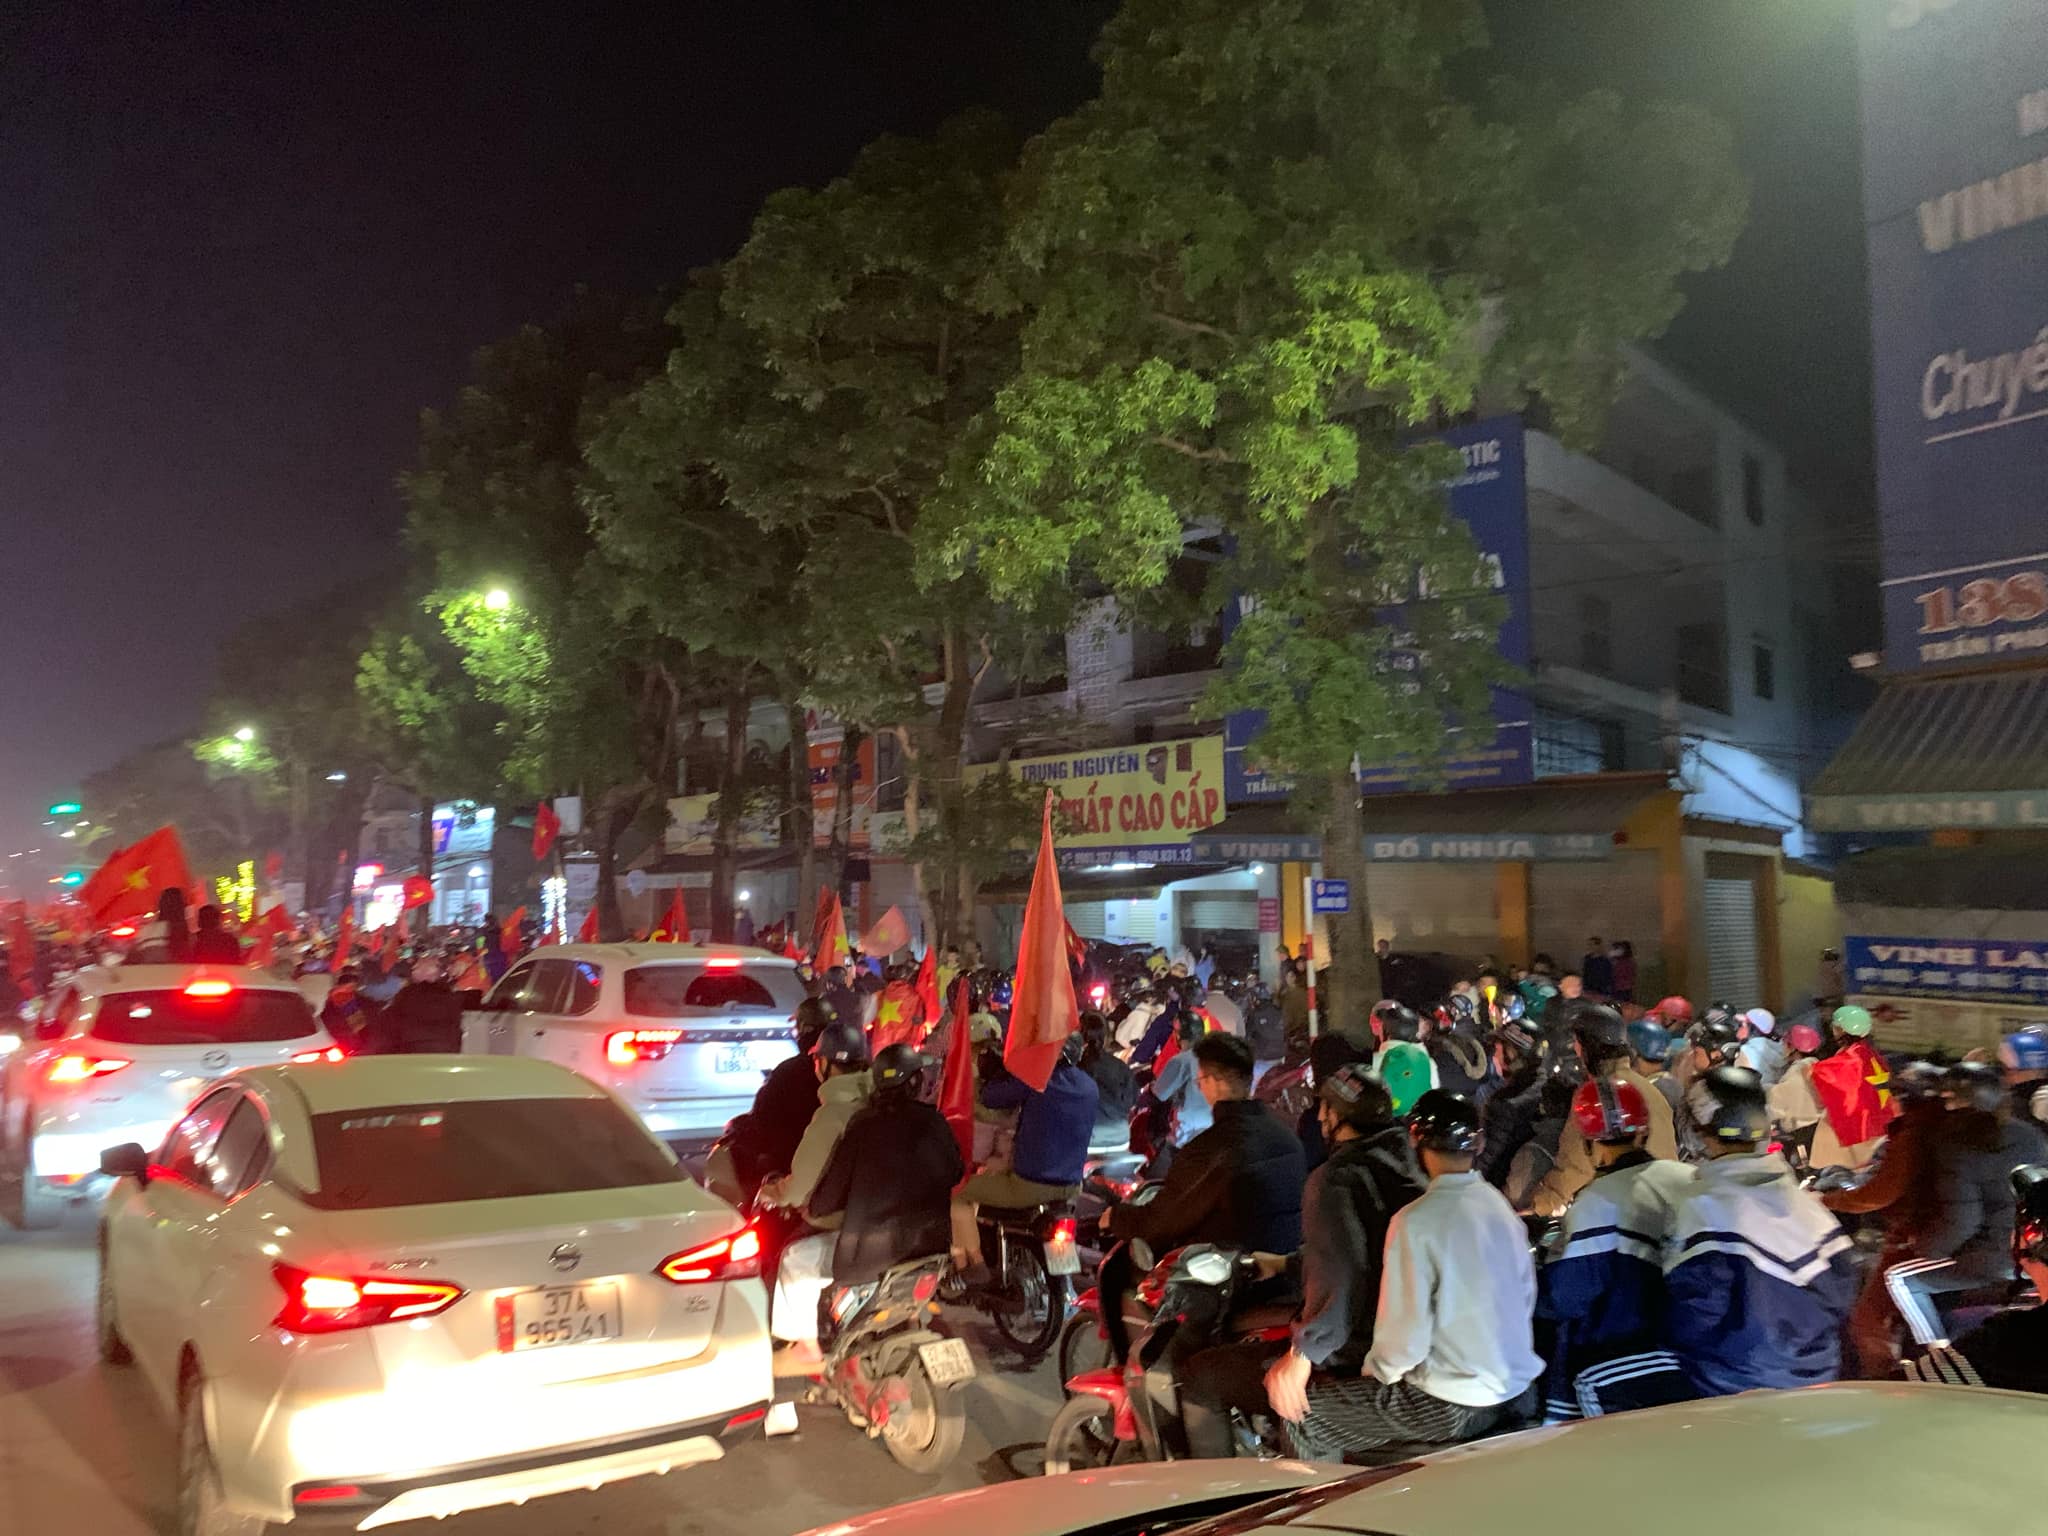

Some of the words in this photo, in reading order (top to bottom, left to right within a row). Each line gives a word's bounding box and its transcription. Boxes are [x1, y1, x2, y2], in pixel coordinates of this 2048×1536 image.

[1021, 761, 1068, 782] TRUNG
[1118, 791, 1165, 833] CAO
[1170, 770, 1220, 830] CẤP
[544, 1289, 590, 1316] 37A
